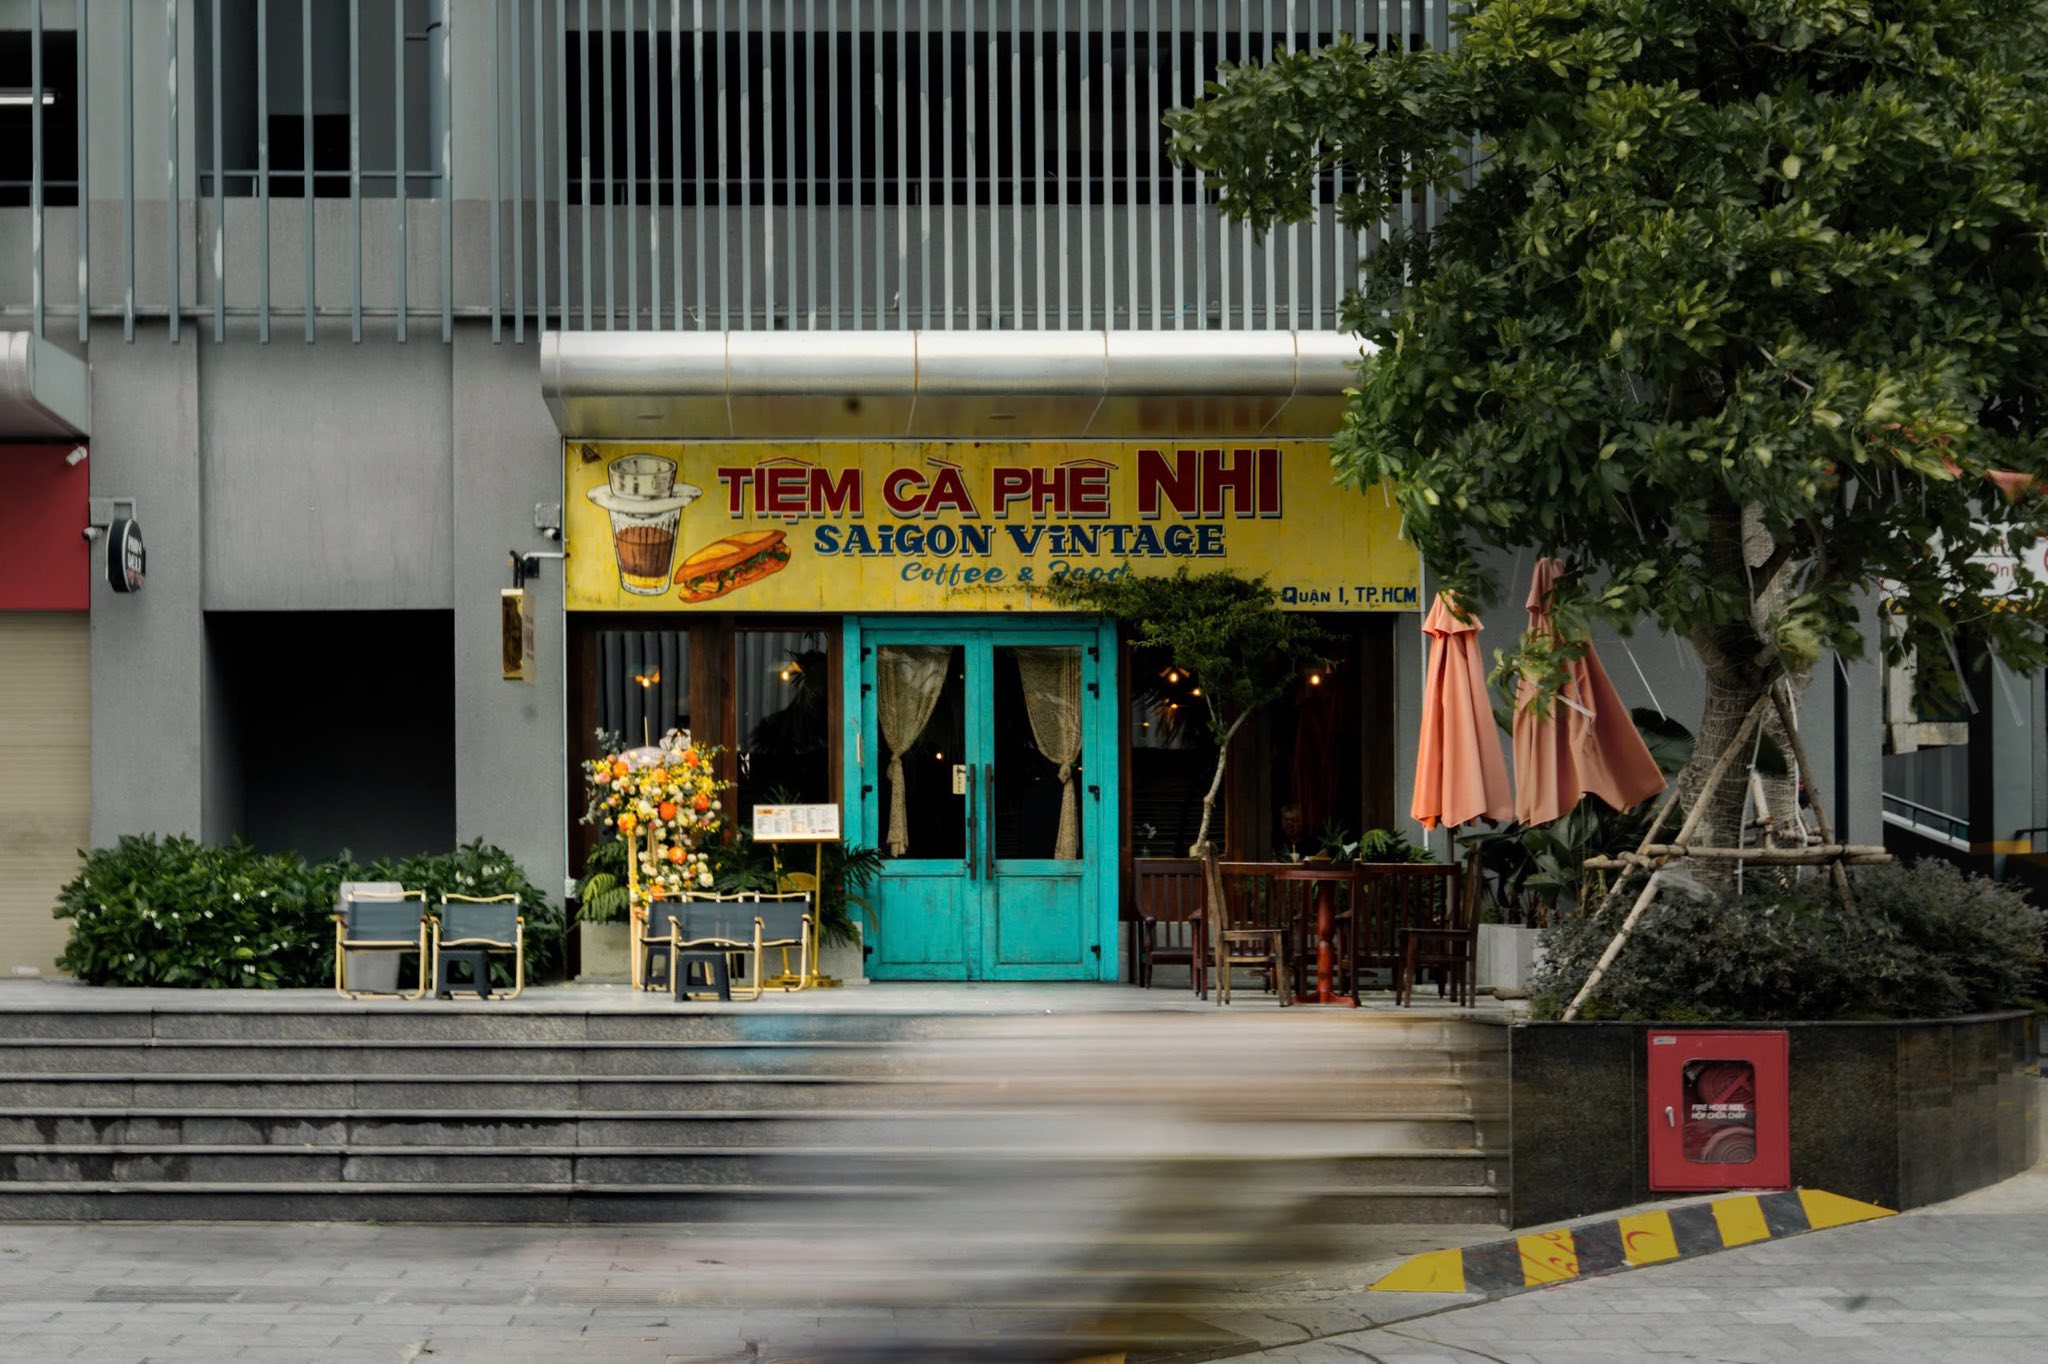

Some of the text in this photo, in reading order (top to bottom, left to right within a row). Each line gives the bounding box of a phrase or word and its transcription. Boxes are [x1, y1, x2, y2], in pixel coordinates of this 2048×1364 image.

[717, 448, 1282, 524] TIỆM CÀ PHÊ NHI
[901, 561, 1007, 586] Coffee
[1018, 566, 1034, 582] &
[1354, 586, 1417, 604] TP.HCM
